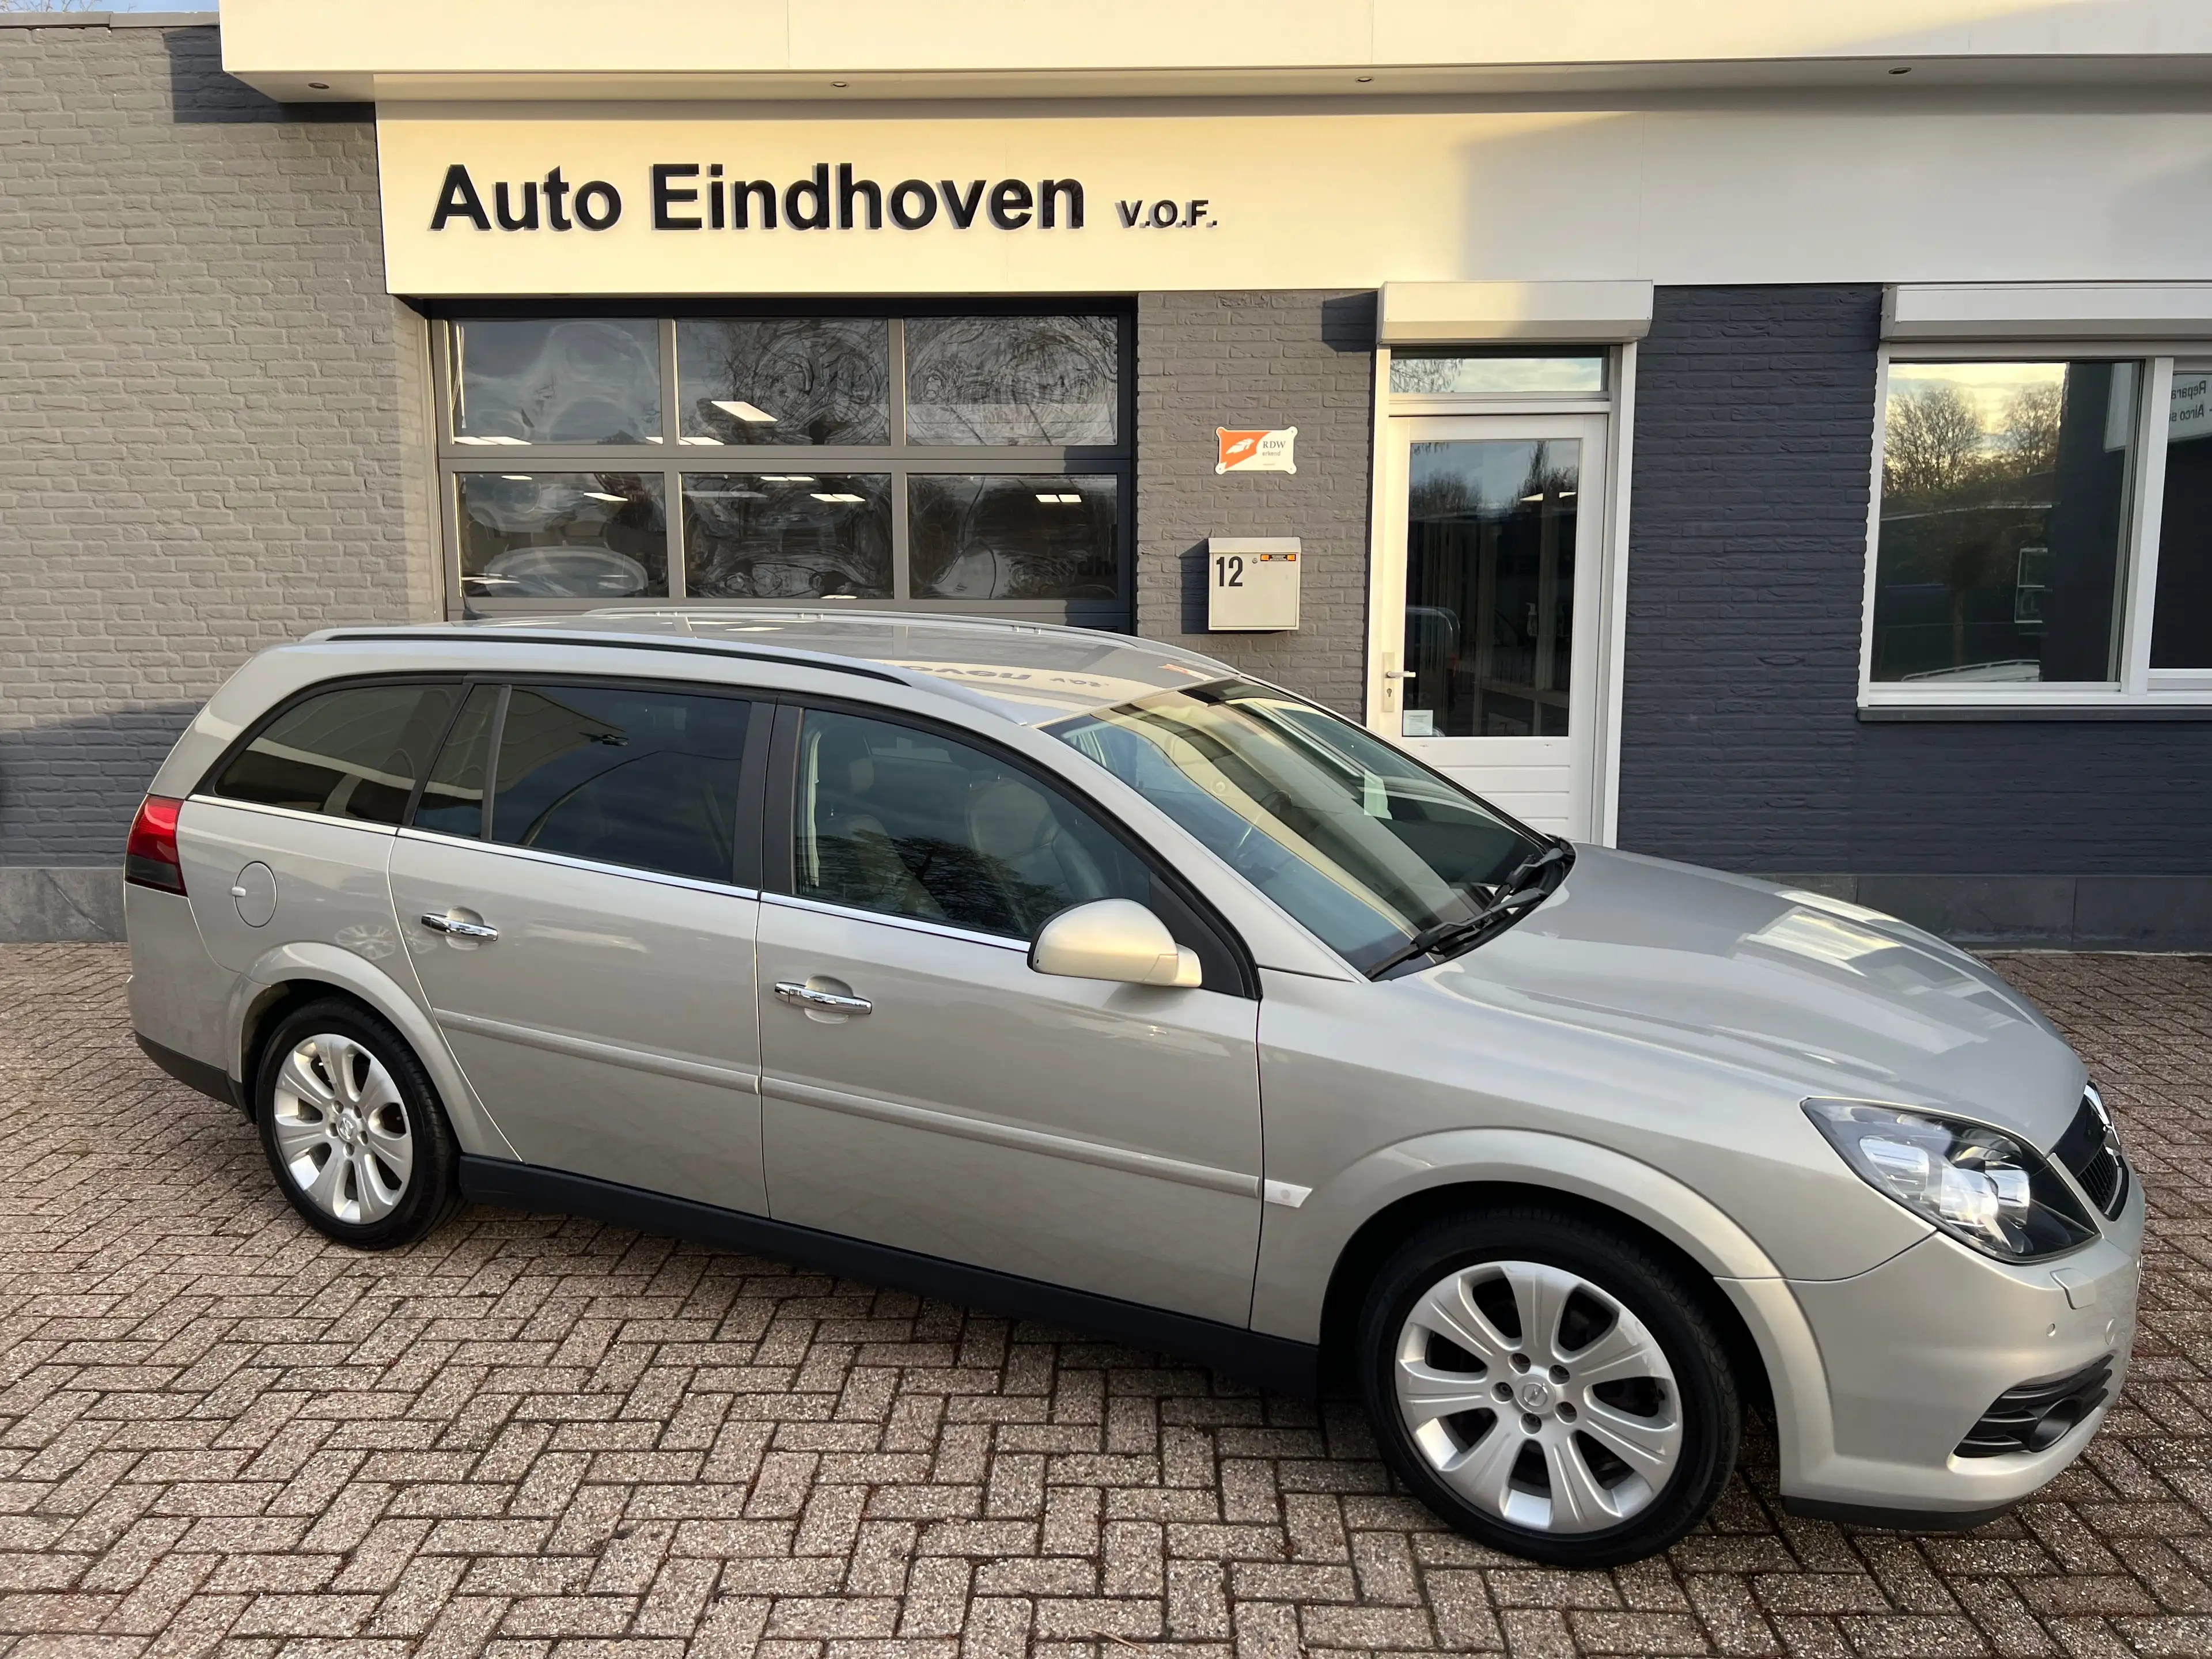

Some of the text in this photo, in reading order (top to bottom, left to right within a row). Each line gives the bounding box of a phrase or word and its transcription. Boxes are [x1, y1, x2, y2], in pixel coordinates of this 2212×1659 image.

[430, 162, 1218, 230] Auto Eindhoven V.O.F.
[1262, 441, 1286, 449] RDW
[1216, 556, 1243, 587] 12
